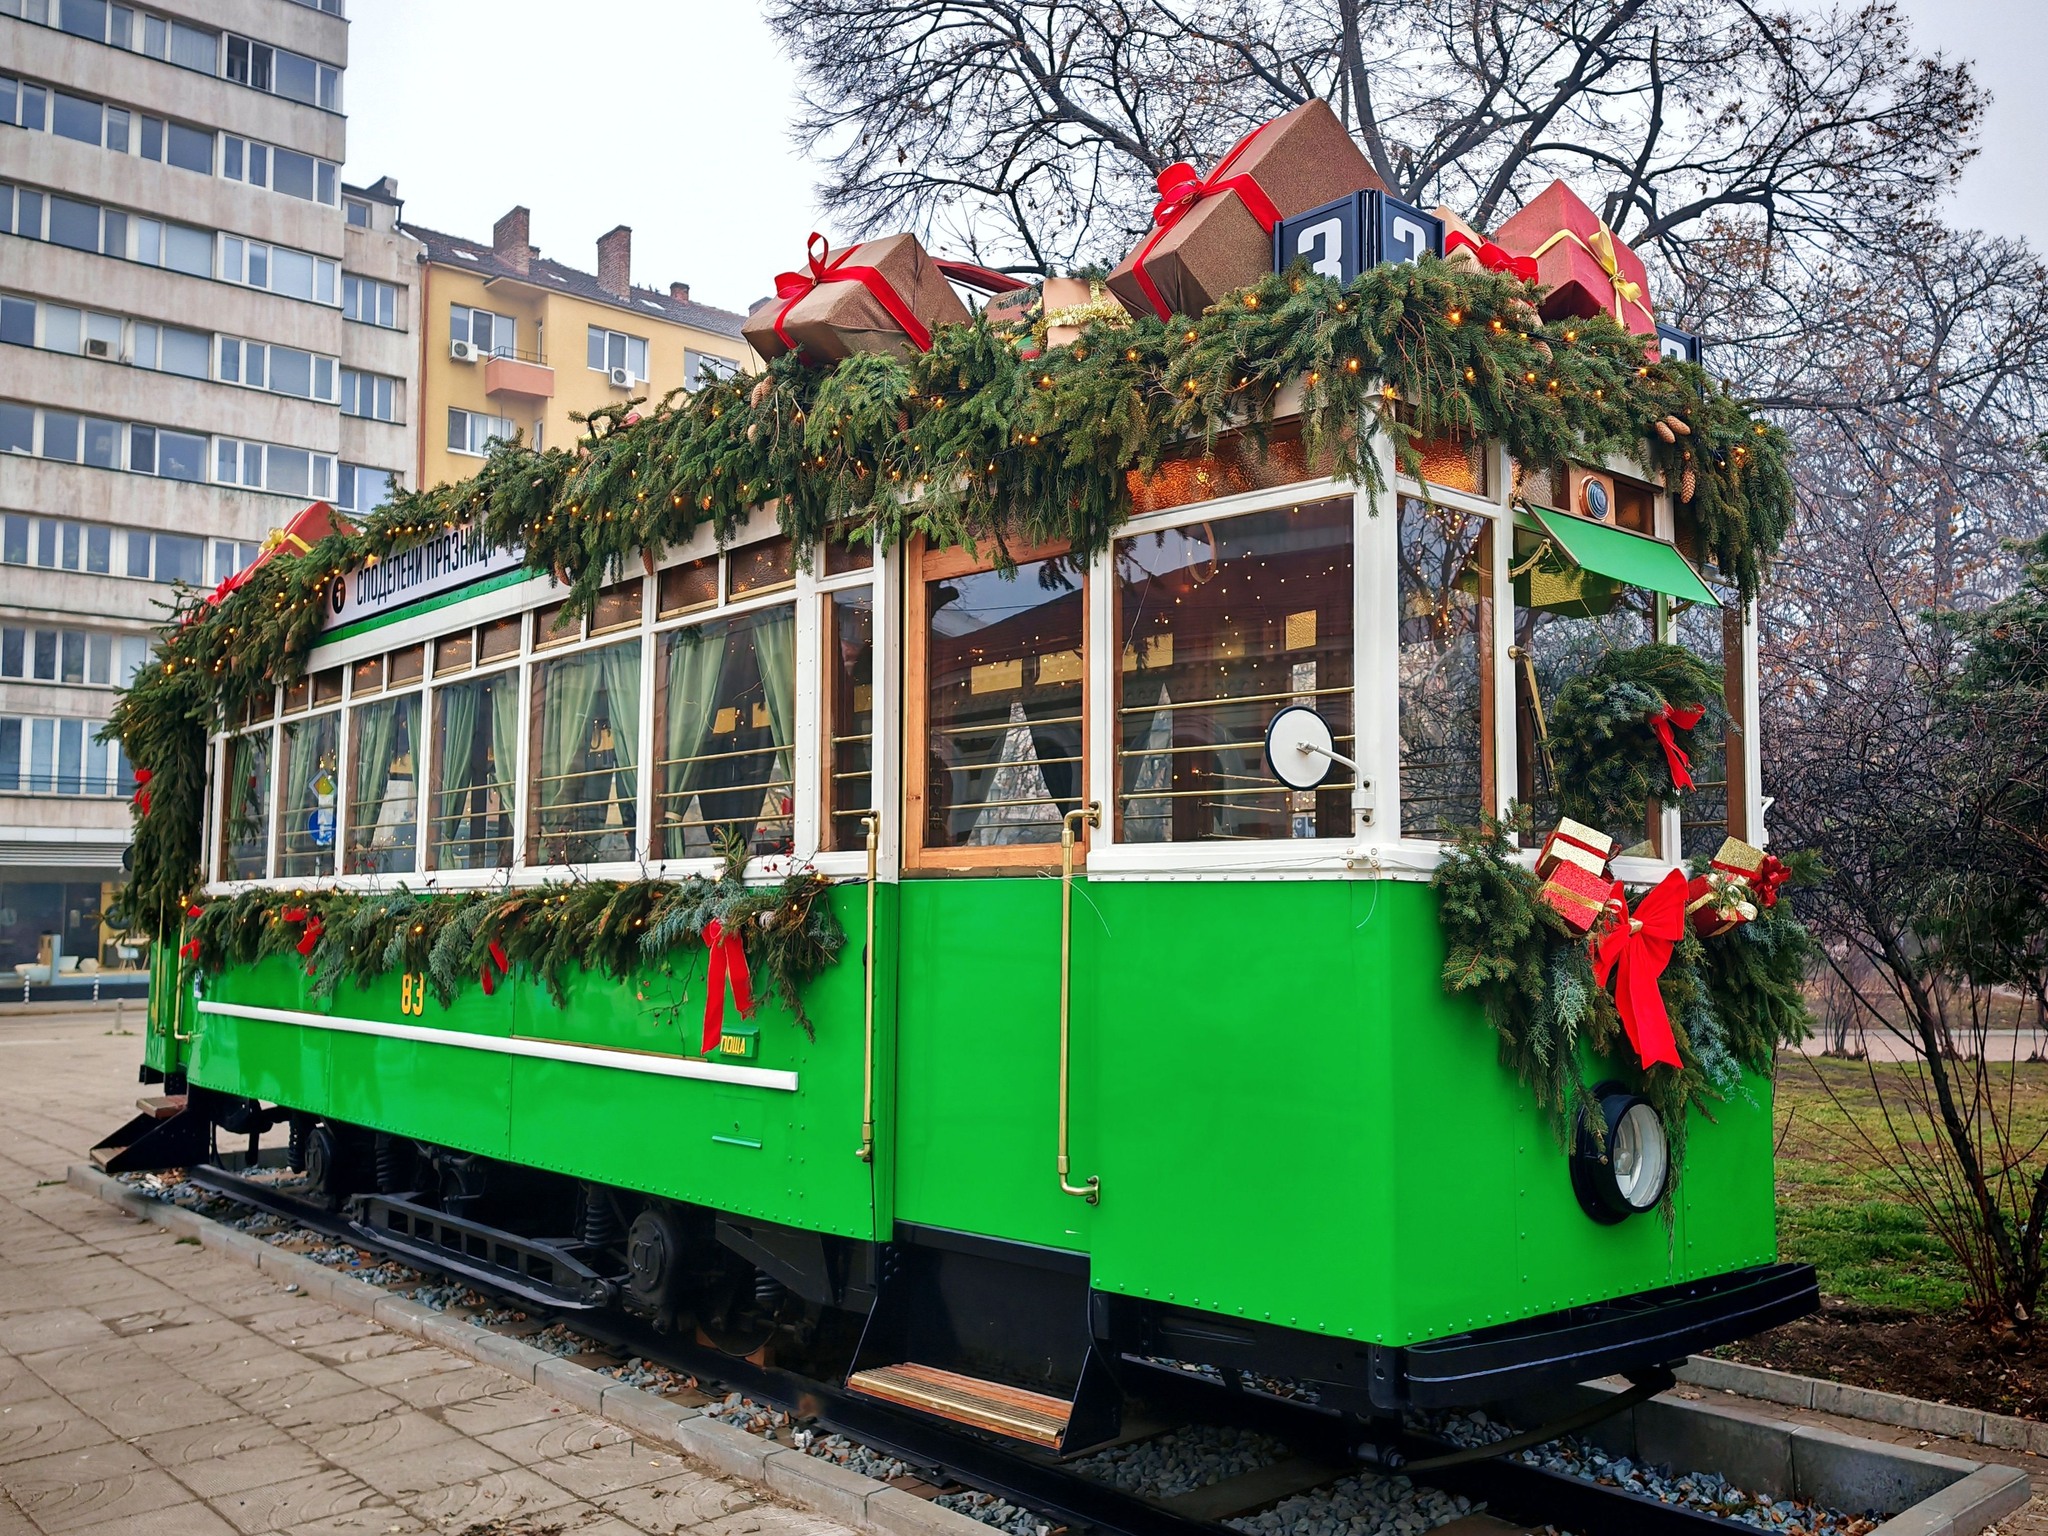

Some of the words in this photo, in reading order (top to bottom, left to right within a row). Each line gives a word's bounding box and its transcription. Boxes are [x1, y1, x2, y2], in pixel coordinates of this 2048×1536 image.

[1298, 217, 1342, 283] 3
[356, 546, 423, 606] СПОДЕЛЕНИ
[401, 971, 424, 1016] 83
[720, 1035, 746, 1055] ПОЩА
